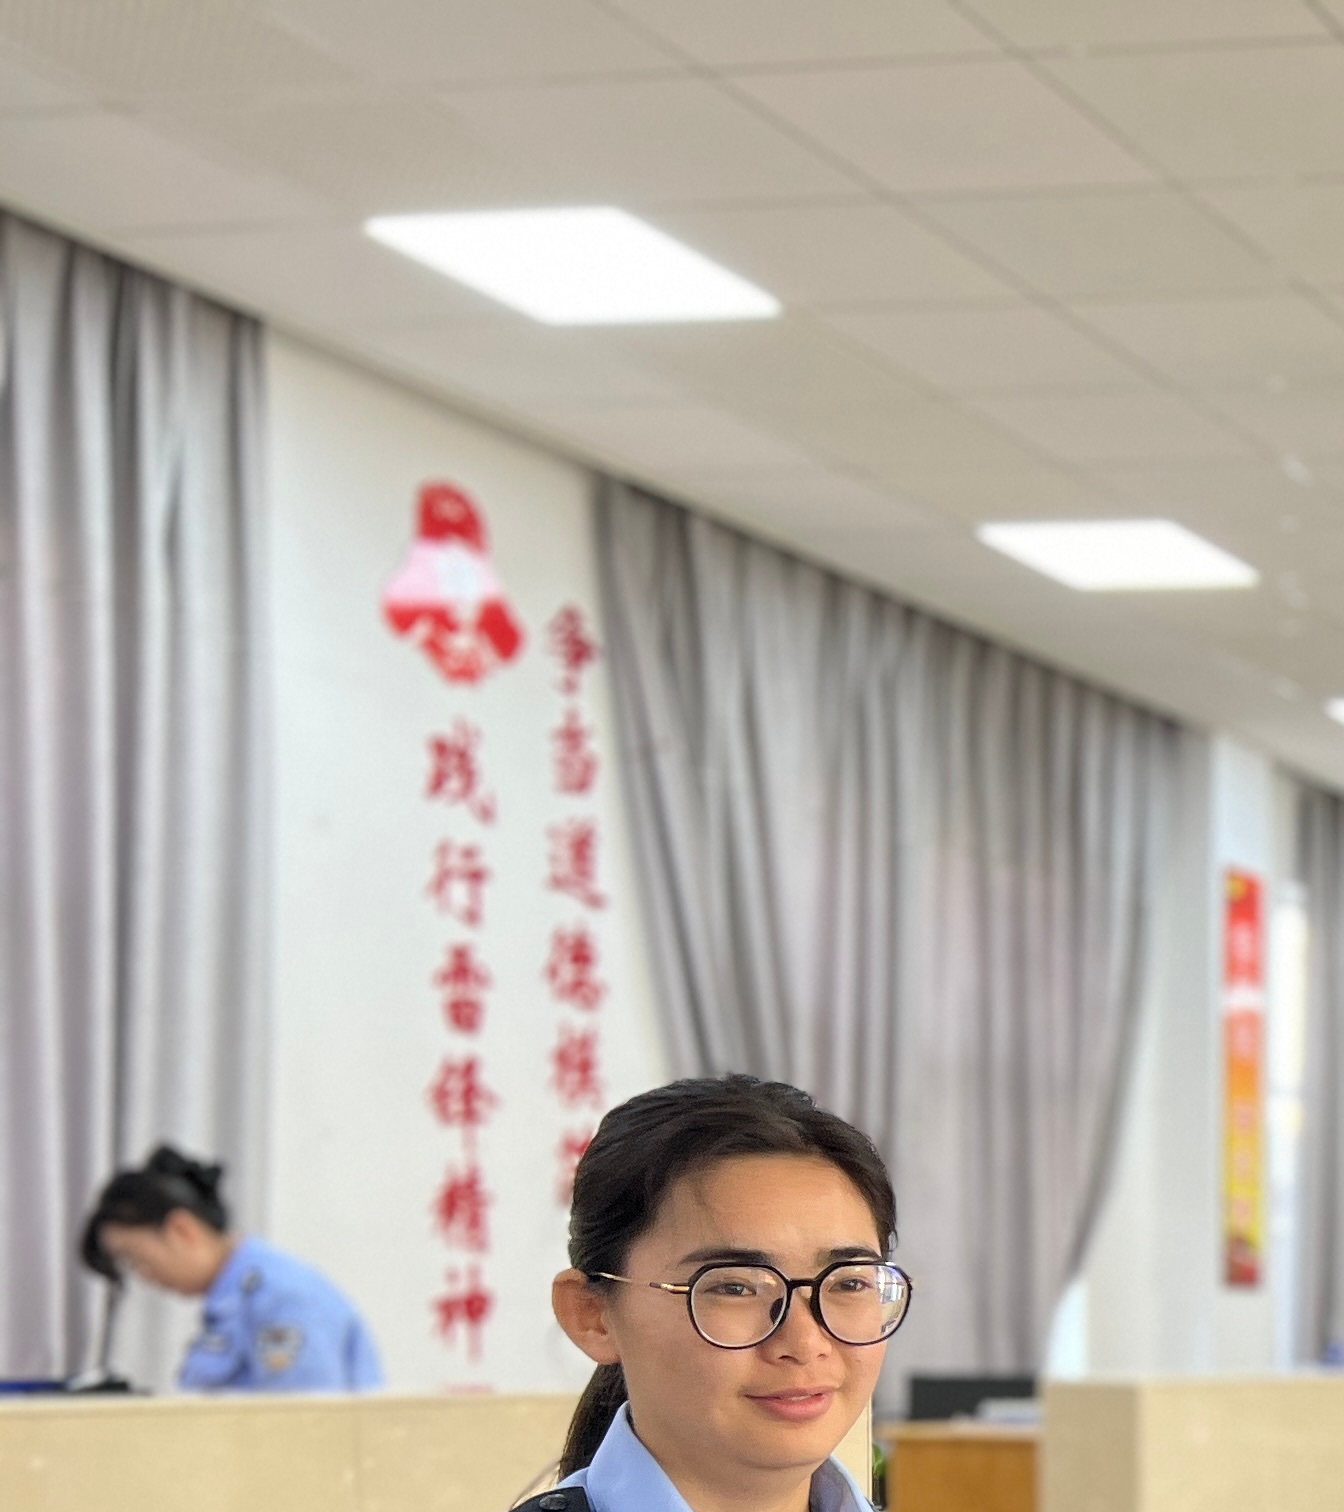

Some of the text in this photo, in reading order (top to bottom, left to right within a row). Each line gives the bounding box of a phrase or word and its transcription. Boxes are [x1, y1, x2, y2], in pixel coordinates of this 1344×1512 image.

[426, 718, 496, 1362] 践行雷锋精神
